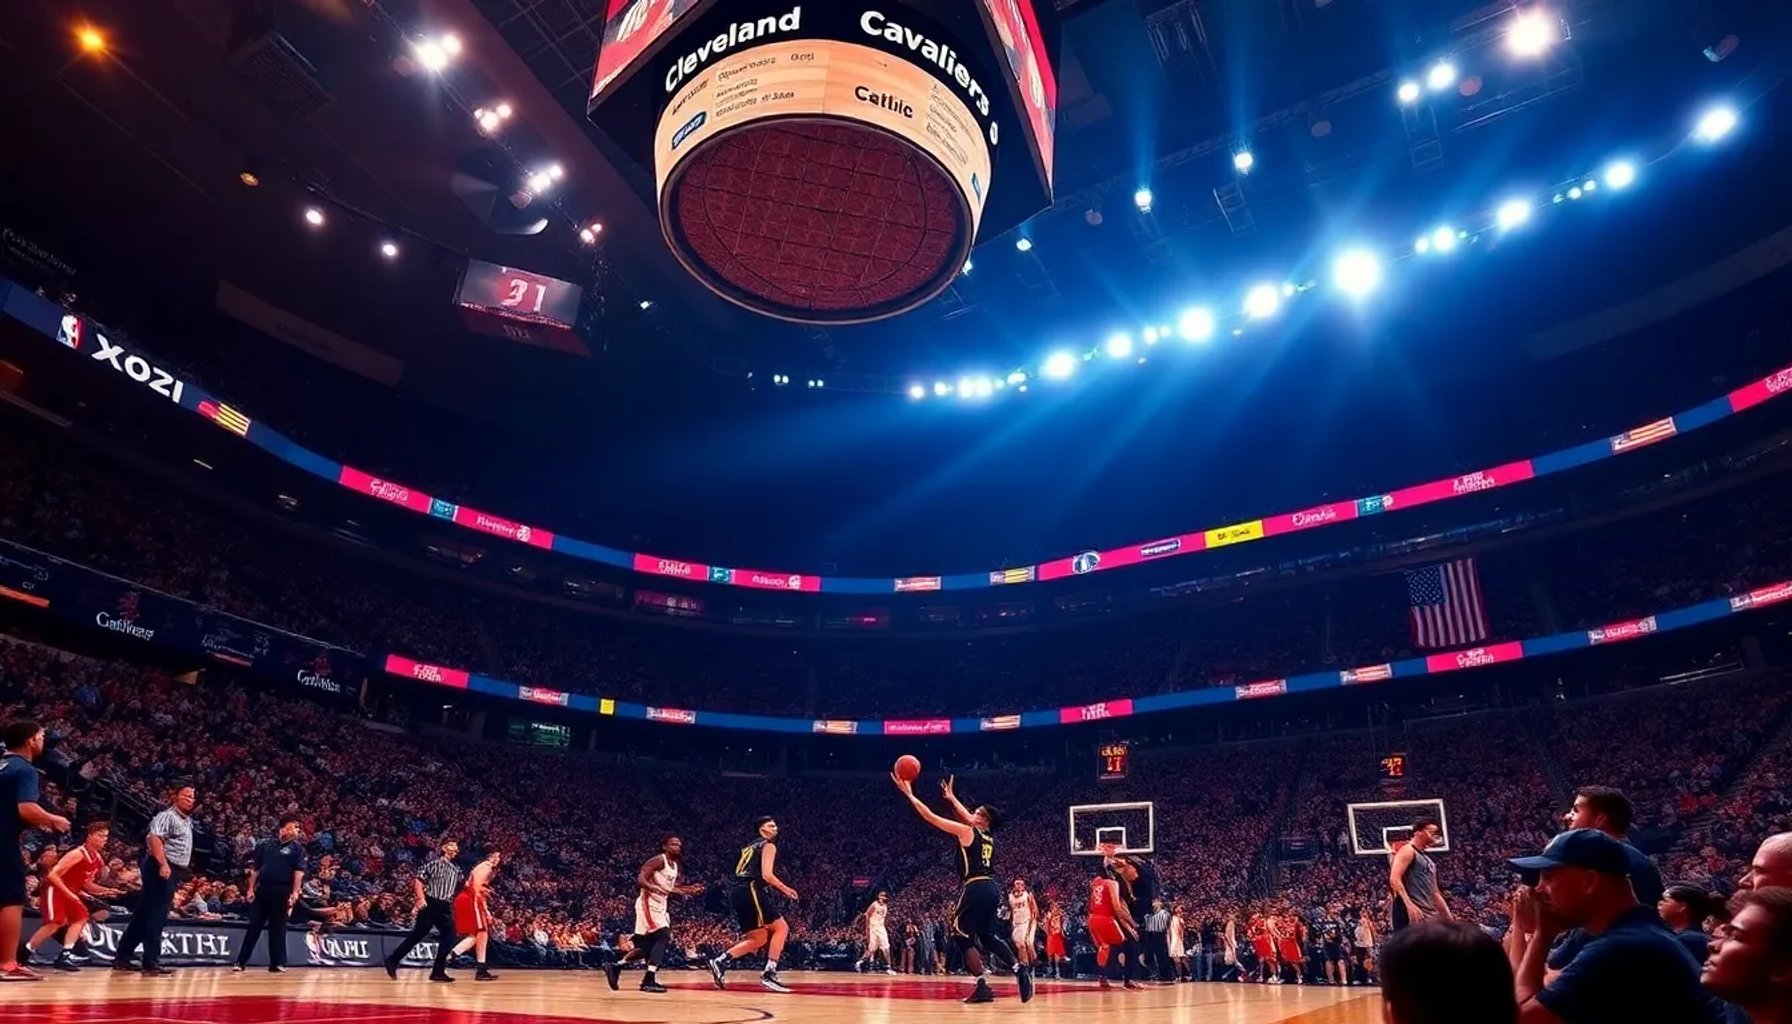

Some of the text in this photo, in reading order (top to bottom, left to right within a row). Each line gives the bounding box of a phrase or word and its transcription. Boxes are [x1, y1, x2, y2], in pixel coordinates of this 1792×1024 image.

[665, 7, 801, 93] Cleveland
[860, 11, 989, 117] Cavaliers
[91, 333, 184, 404] XOZI
